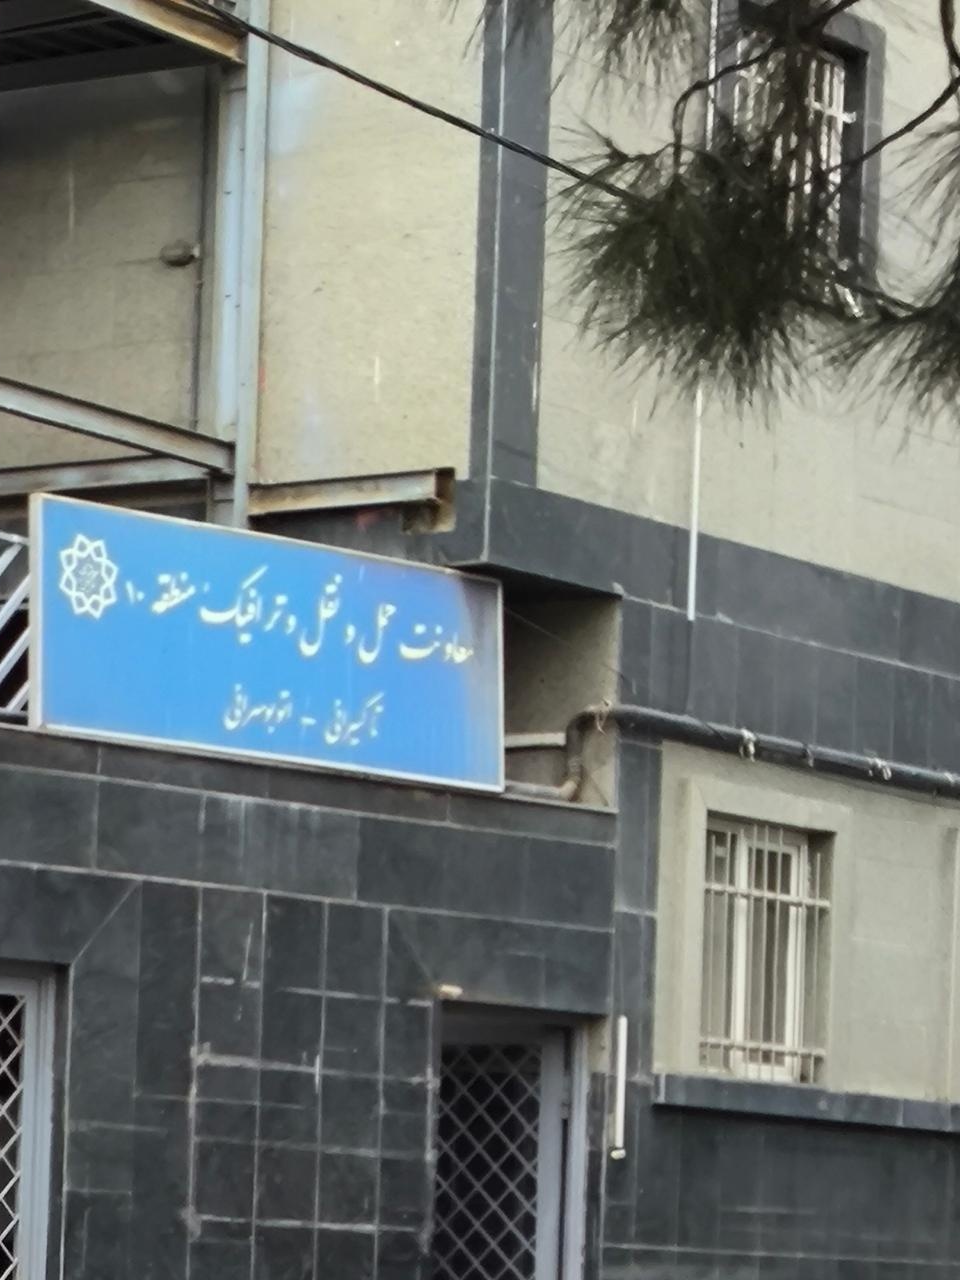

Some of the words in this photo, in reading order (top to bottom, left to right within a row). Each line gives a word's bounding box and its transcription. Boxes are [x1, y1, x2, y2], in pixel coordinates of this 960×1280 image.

[151, 571, 197, 615] منطقه
[199, 564, 288, 645] ترافیک
[299, 573, 343, 657] نقل
[285, 613, 297, 636] و
[344, 623, 357, 646] و
[358, 603, 397, 664] حمل
[399, 623, 475, 664] معاونت
